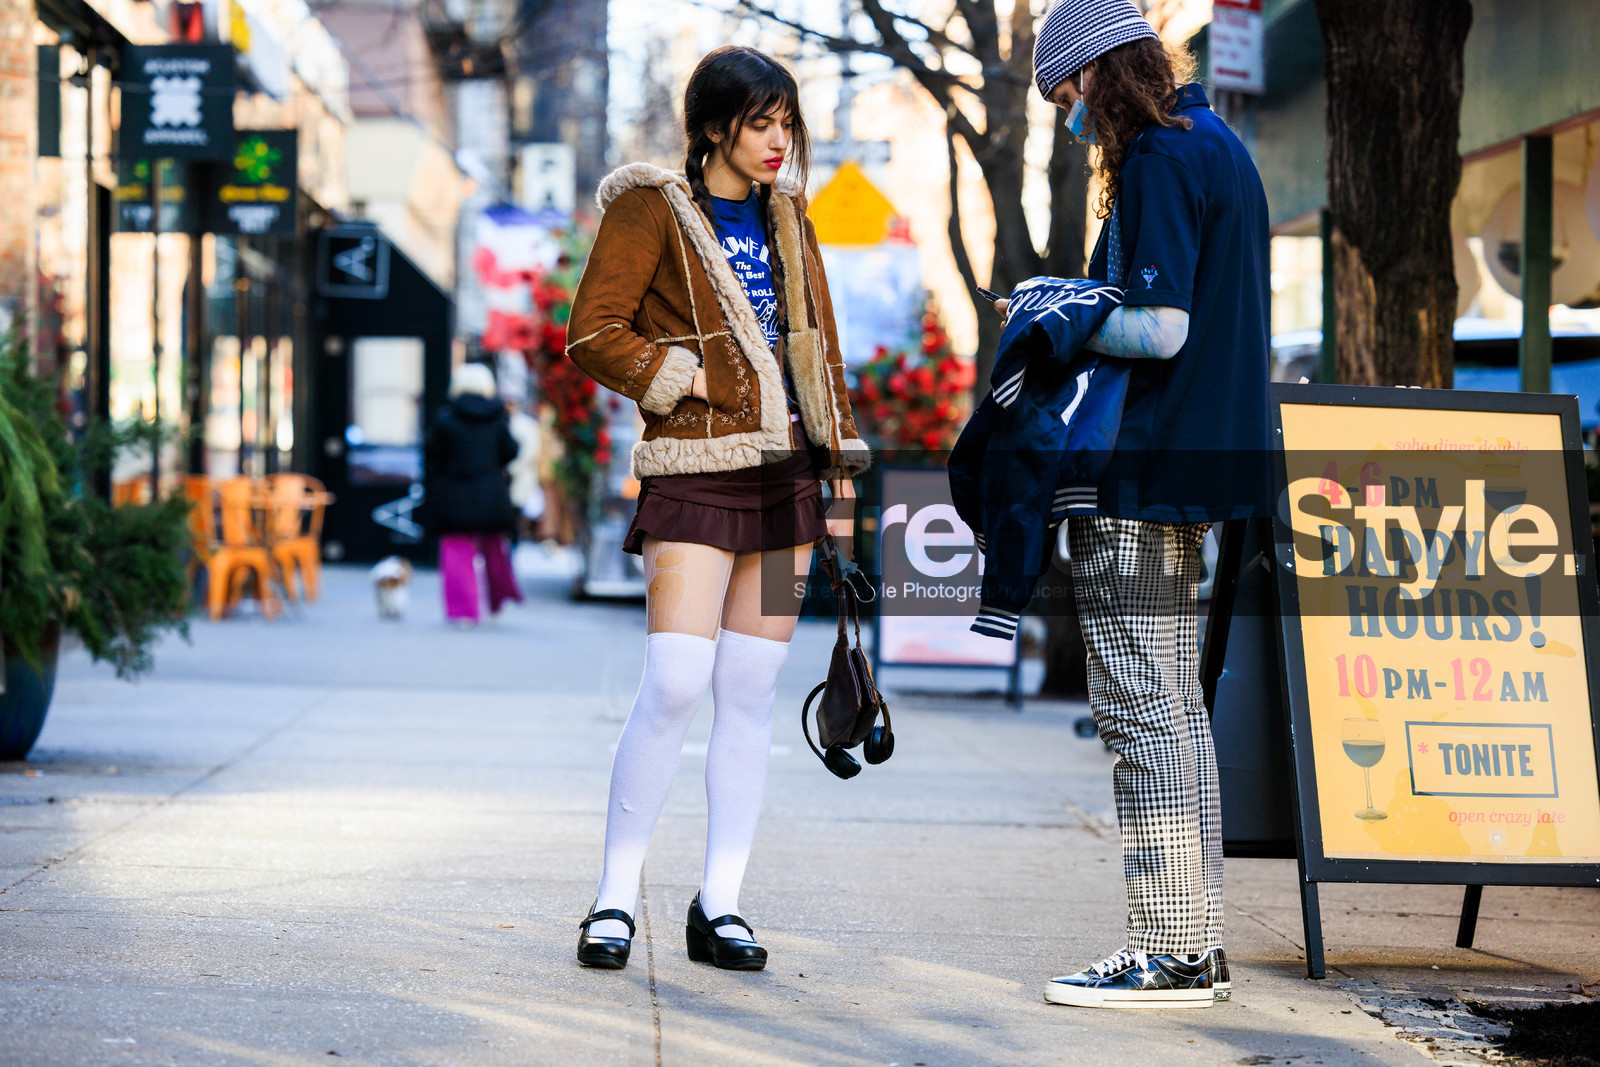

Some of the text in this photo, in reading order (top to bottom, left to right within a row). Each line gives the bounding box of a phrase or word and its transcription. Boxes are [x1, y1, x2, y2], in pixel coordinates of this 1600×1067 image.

[735, 261, 751, 270] The
[746, 271, 765, 279] Best
[752, 288, 775, 297] ROLL
[1395, 437, 1529, 456] soho diner double
[1318, 524, 1486, 581] HAPPY
[1345, 573, 1547, 648] HOURS!
[1438, 742, 1534, 777] TONITE
[1449, 808, 1566, 827] open crazy late
